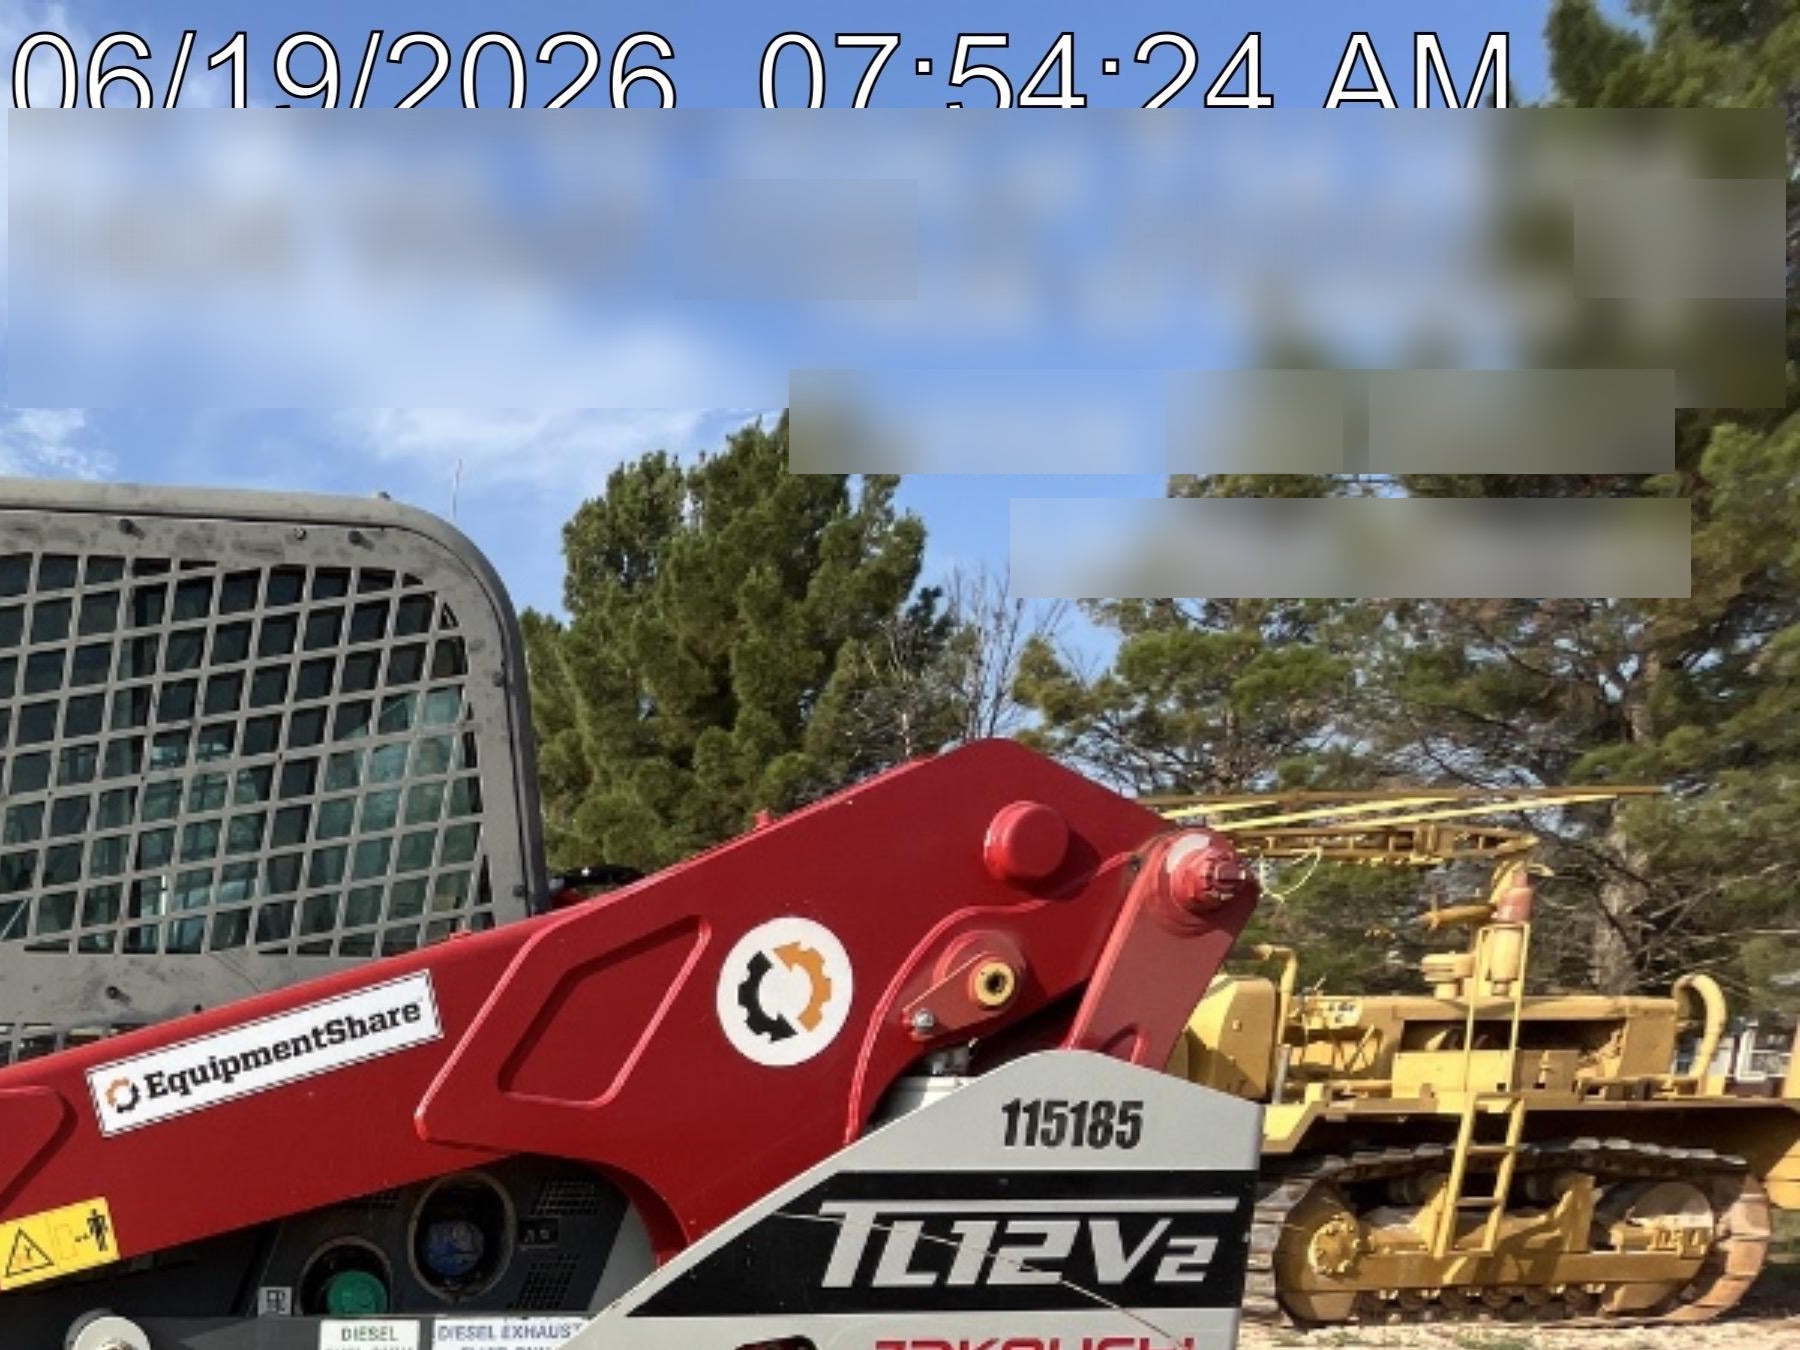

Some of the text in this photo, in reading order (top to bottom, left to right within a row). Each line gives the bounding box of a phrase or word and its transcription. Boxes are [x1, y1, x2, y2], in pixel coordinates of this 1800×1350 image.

[143, 999, 422, 1100] EquipmentShare
[1001, 1099, 1144, 1149] 115185
[340, 1325, 400, 1342] DIESEL
[438, 1324, 499, 1342] DIESEL
